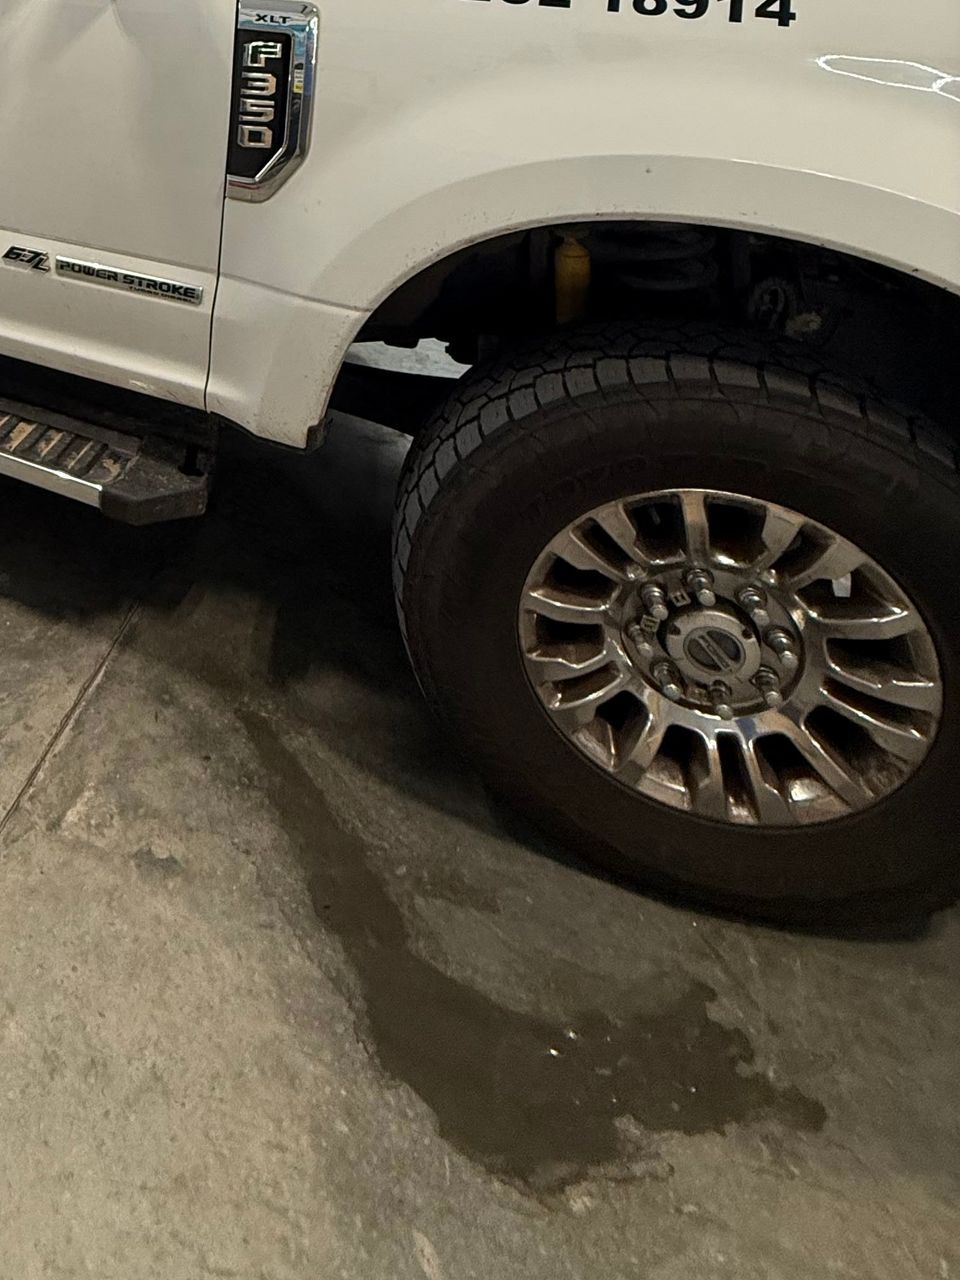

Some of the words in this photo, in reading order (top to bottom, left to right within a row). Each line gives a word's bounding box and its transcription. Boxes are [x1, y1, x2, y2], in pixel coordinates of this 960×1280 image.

[254, 13, 291, 24] XLT
[59, 260, 119, 281] POWER
[123, 274, 196, 299] STROKE
